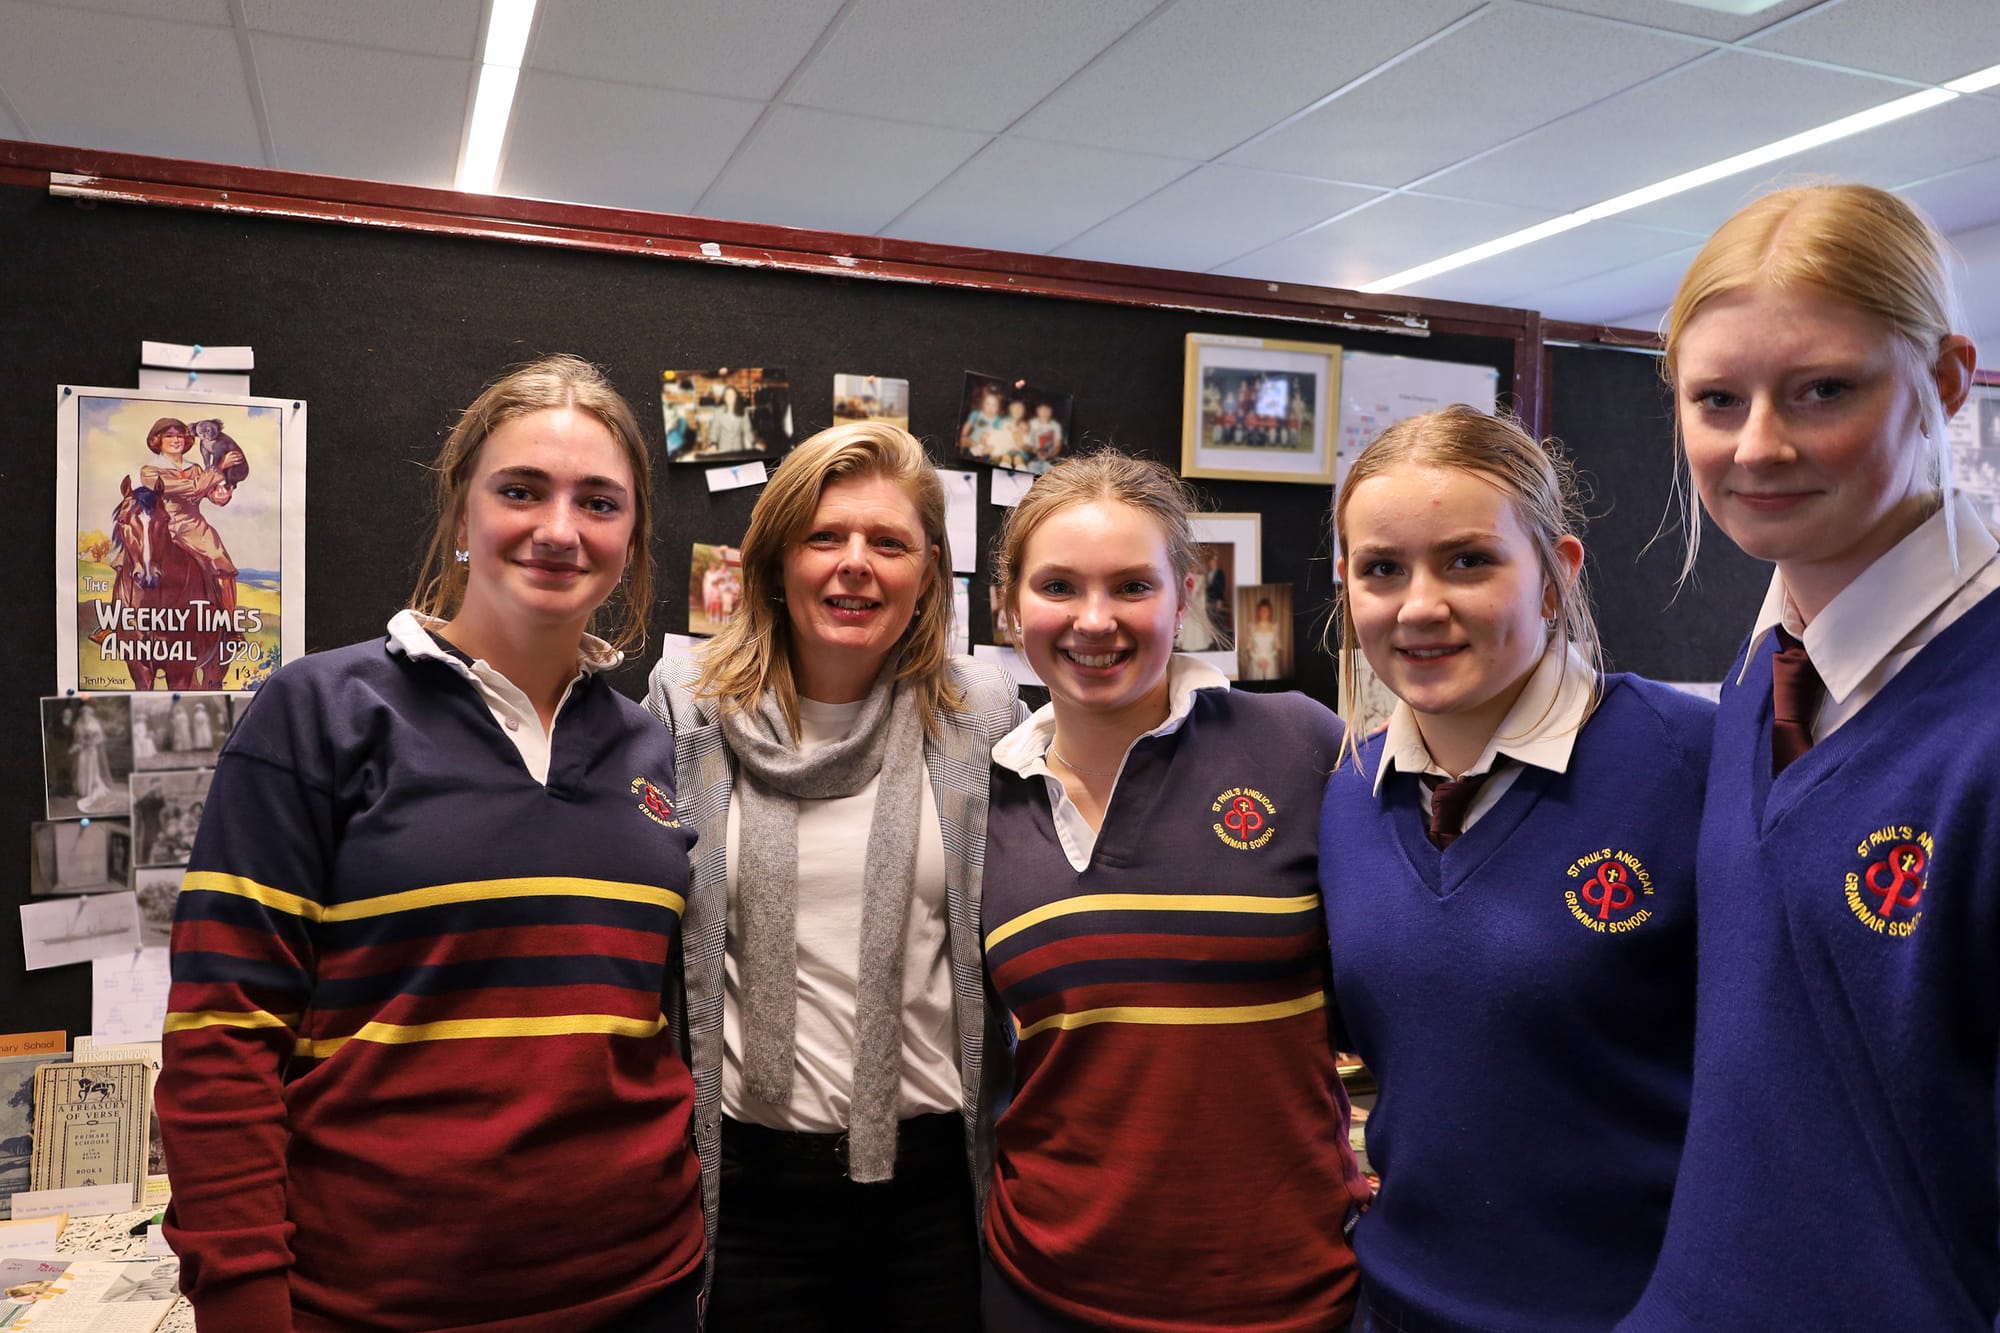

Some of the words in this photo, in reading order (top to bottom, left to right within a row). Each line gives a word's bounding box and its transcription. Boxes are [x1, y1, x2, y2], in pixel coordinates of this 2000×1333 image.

[83, 576, 109, 592] THE
[95, 599, 190, 631] WEEKLY
[190, 600, 263, 633] TIMES
[100, 632, 197, 661] ANNUAL
[219, 641, 260, 666] 1920
[84, 676, 105, 685] Tenth
[105, 677, 127, 687] Year
[1212, 802, 1222, 812] ST
[1217, 787, 1241, 804] PAUL'S
[1243, 788, 1276, 815] ANGLICAN
[1213, 823, 1248, 850] GRAMMAR
[1249, 826, 1275, 850] SCHOOL
[1857, 839, 1871, 858] ST
[1869, 825, 1913, 847] PAUL'S
[1567, 864, 1581, 878] ST
[1577, 848, 1612, 869] PAUL'S
[1614, 850, 1655, 895] ANGLICAN
[1564, 890, 1606, 933] GRAMMAR
[1609, 908, 1652, 933] SCHOOL
[1845, 872, 1885, 934] GRAMMAR
[24, 1040, 54, 1050] School
[57, 1105, 65, 1113] A
[69, 1101, 127, 1112] TREASURY
[66, 1113, 81, 1121] OF
[86, 1110, 120, 1119] VERSE
